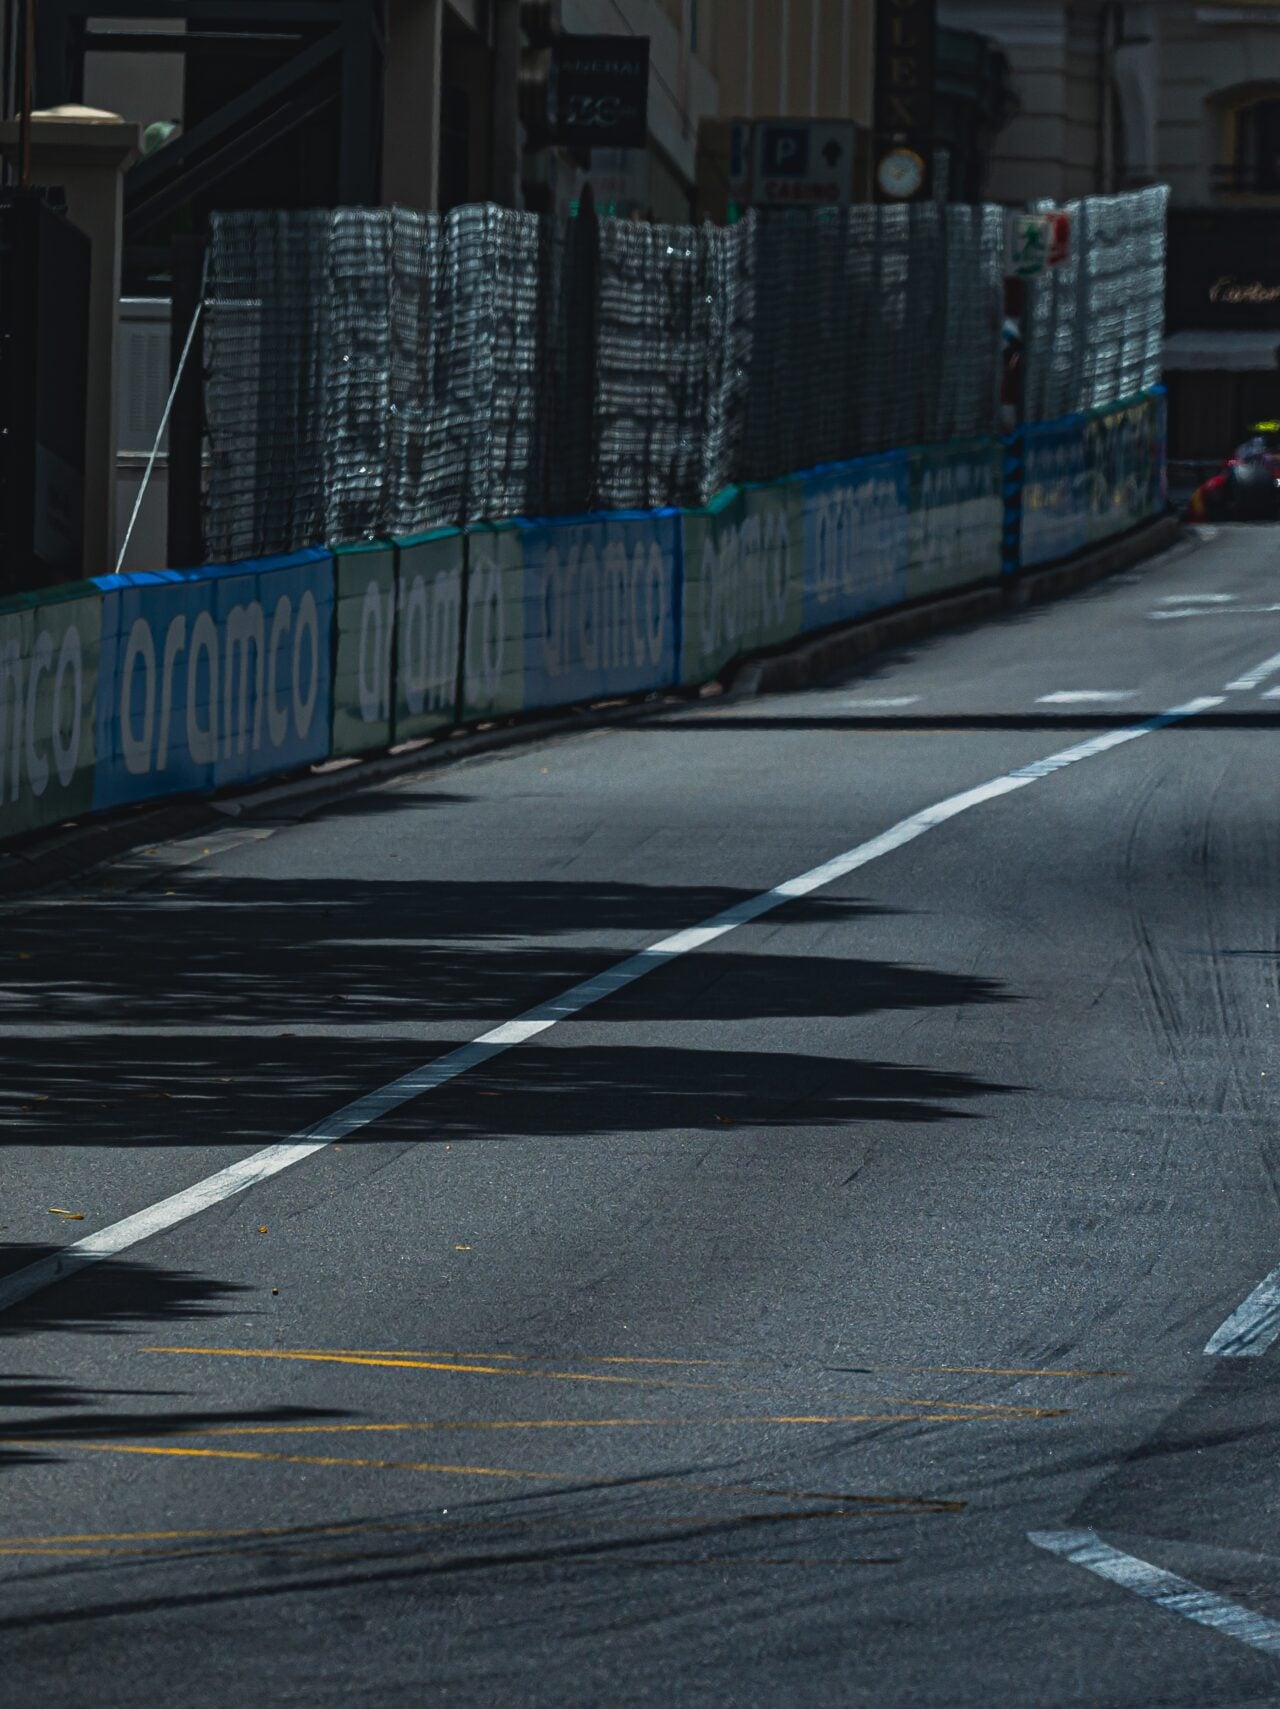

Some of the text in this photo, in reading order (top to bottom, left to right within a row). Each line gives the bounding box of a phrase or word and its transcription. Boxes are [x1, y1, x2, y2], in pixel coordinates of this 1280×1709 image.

[775, 136, 797, 168] P
[543, 540, 664, 677] aramco
[120, 590, 318, 775] aramco
